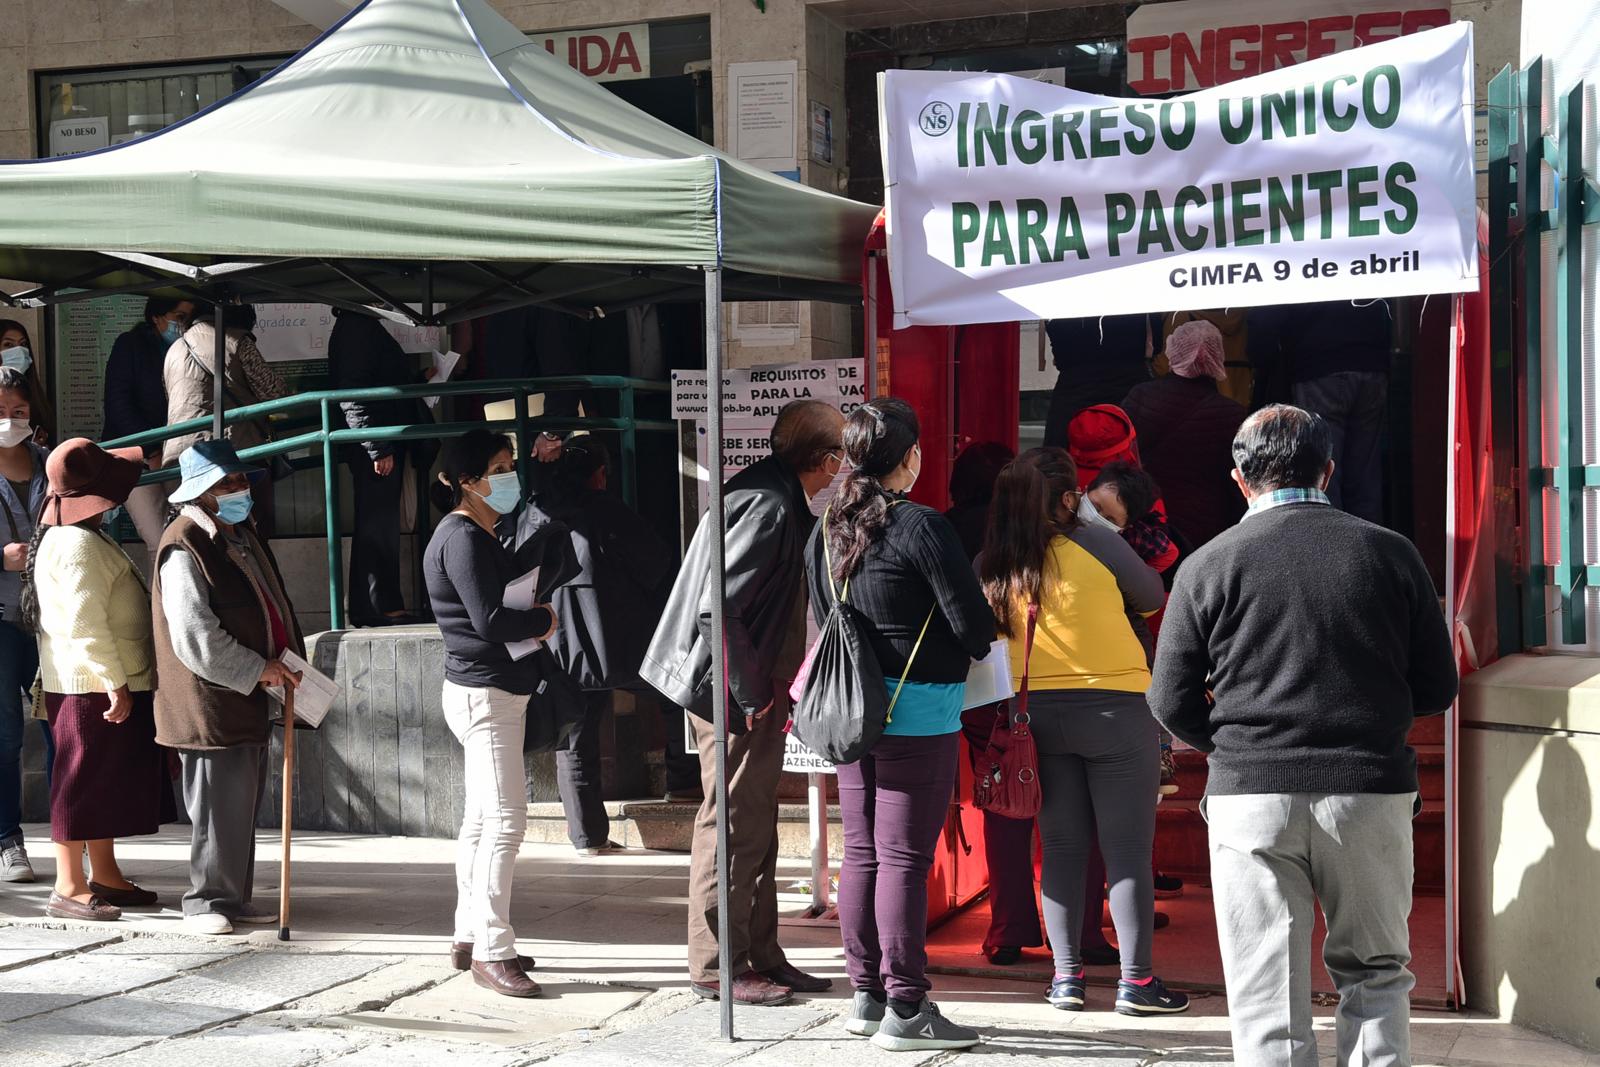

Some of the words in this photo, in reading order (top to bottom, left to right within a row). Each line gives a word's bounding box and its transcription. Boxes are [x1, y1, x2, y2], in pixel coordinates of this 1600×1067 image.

[1127, 8, 1450, 95] INGRES
[957, 100, 1196, 168] INGRESO
[1218, 64, 1401, 145] UNICO
[60, 128, 72, 137] NO
[75, 127, 97, 136] BESO
[951, 196, 1090, 268] PARA
[1104, 160, 1419, 257] PACIENTES
[1168, 262, 1264, 289] CIMFA
[1273, 259, 1291, 281] 9
[1301, 256, 1339, 279] de
[1349, 250, 1420, 275] abril
[750, 368, 826, 383] REQUISITOS
[837, 367, 857, 378] DE
[677, 379, 693, 388] pre
[677, 393, 699, 401] para
[751, 388, 790, 400] PARA
[793, 386, 812, 398] LA
[747, 438, 770, 449] SER
